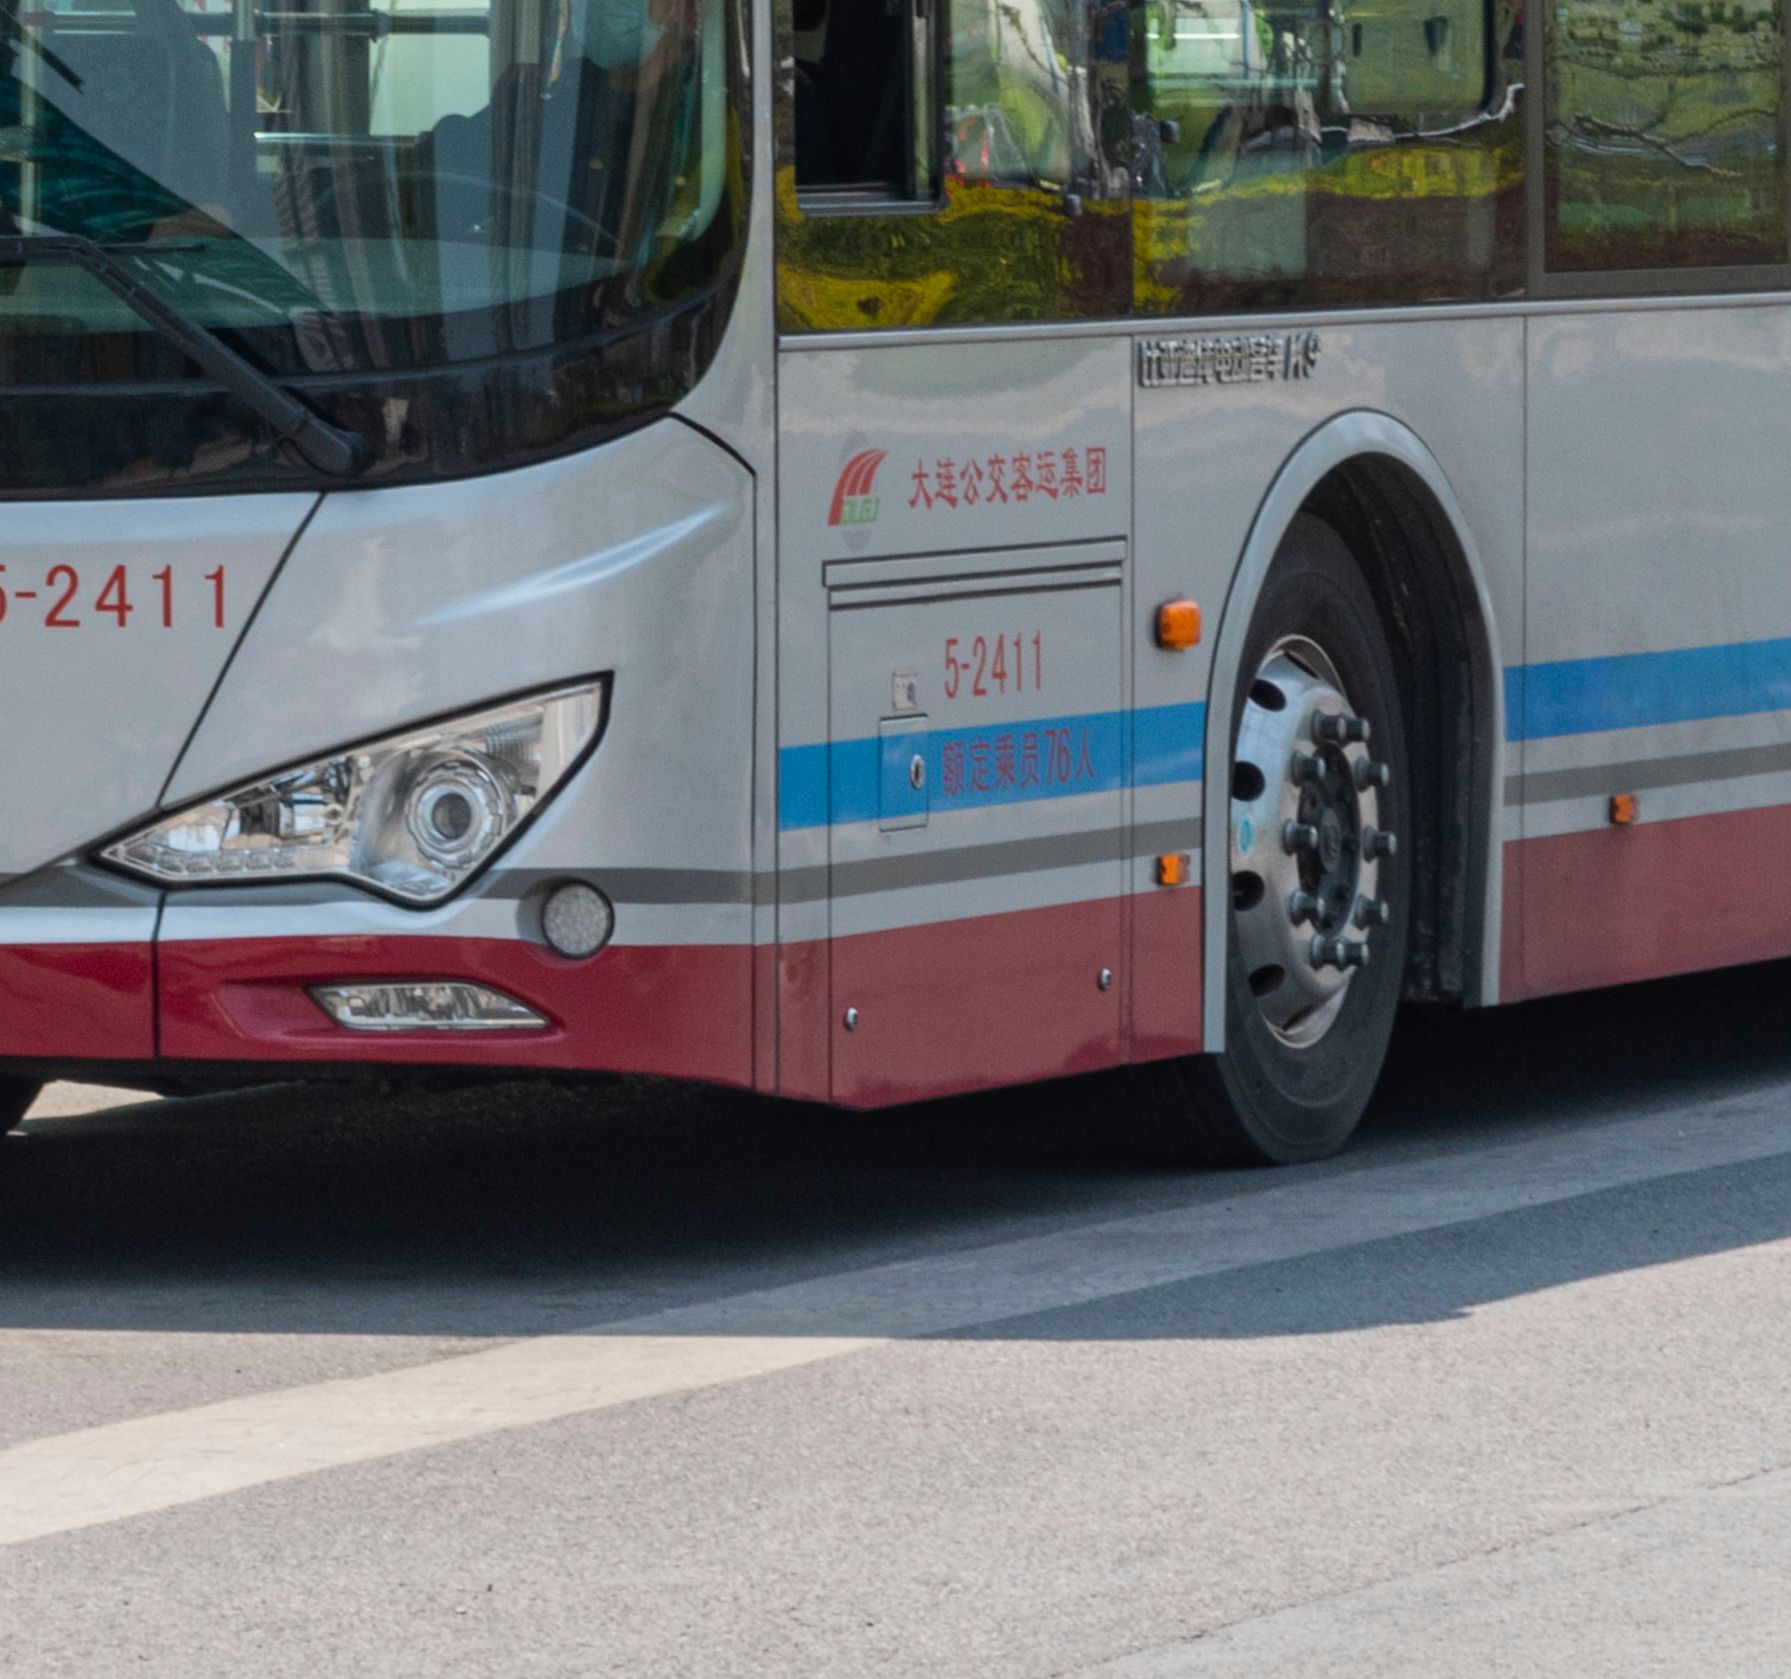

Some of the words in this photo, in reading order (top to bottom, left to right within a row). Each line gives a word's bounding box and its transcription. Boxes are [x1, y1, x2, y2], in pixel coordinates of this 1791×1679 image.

[908, 446, 1107, 511] 大连公交客运集团
[944, 629, 1042, 700] 5-2411
[942, 724, 1096, 798] 额定乘员76人
